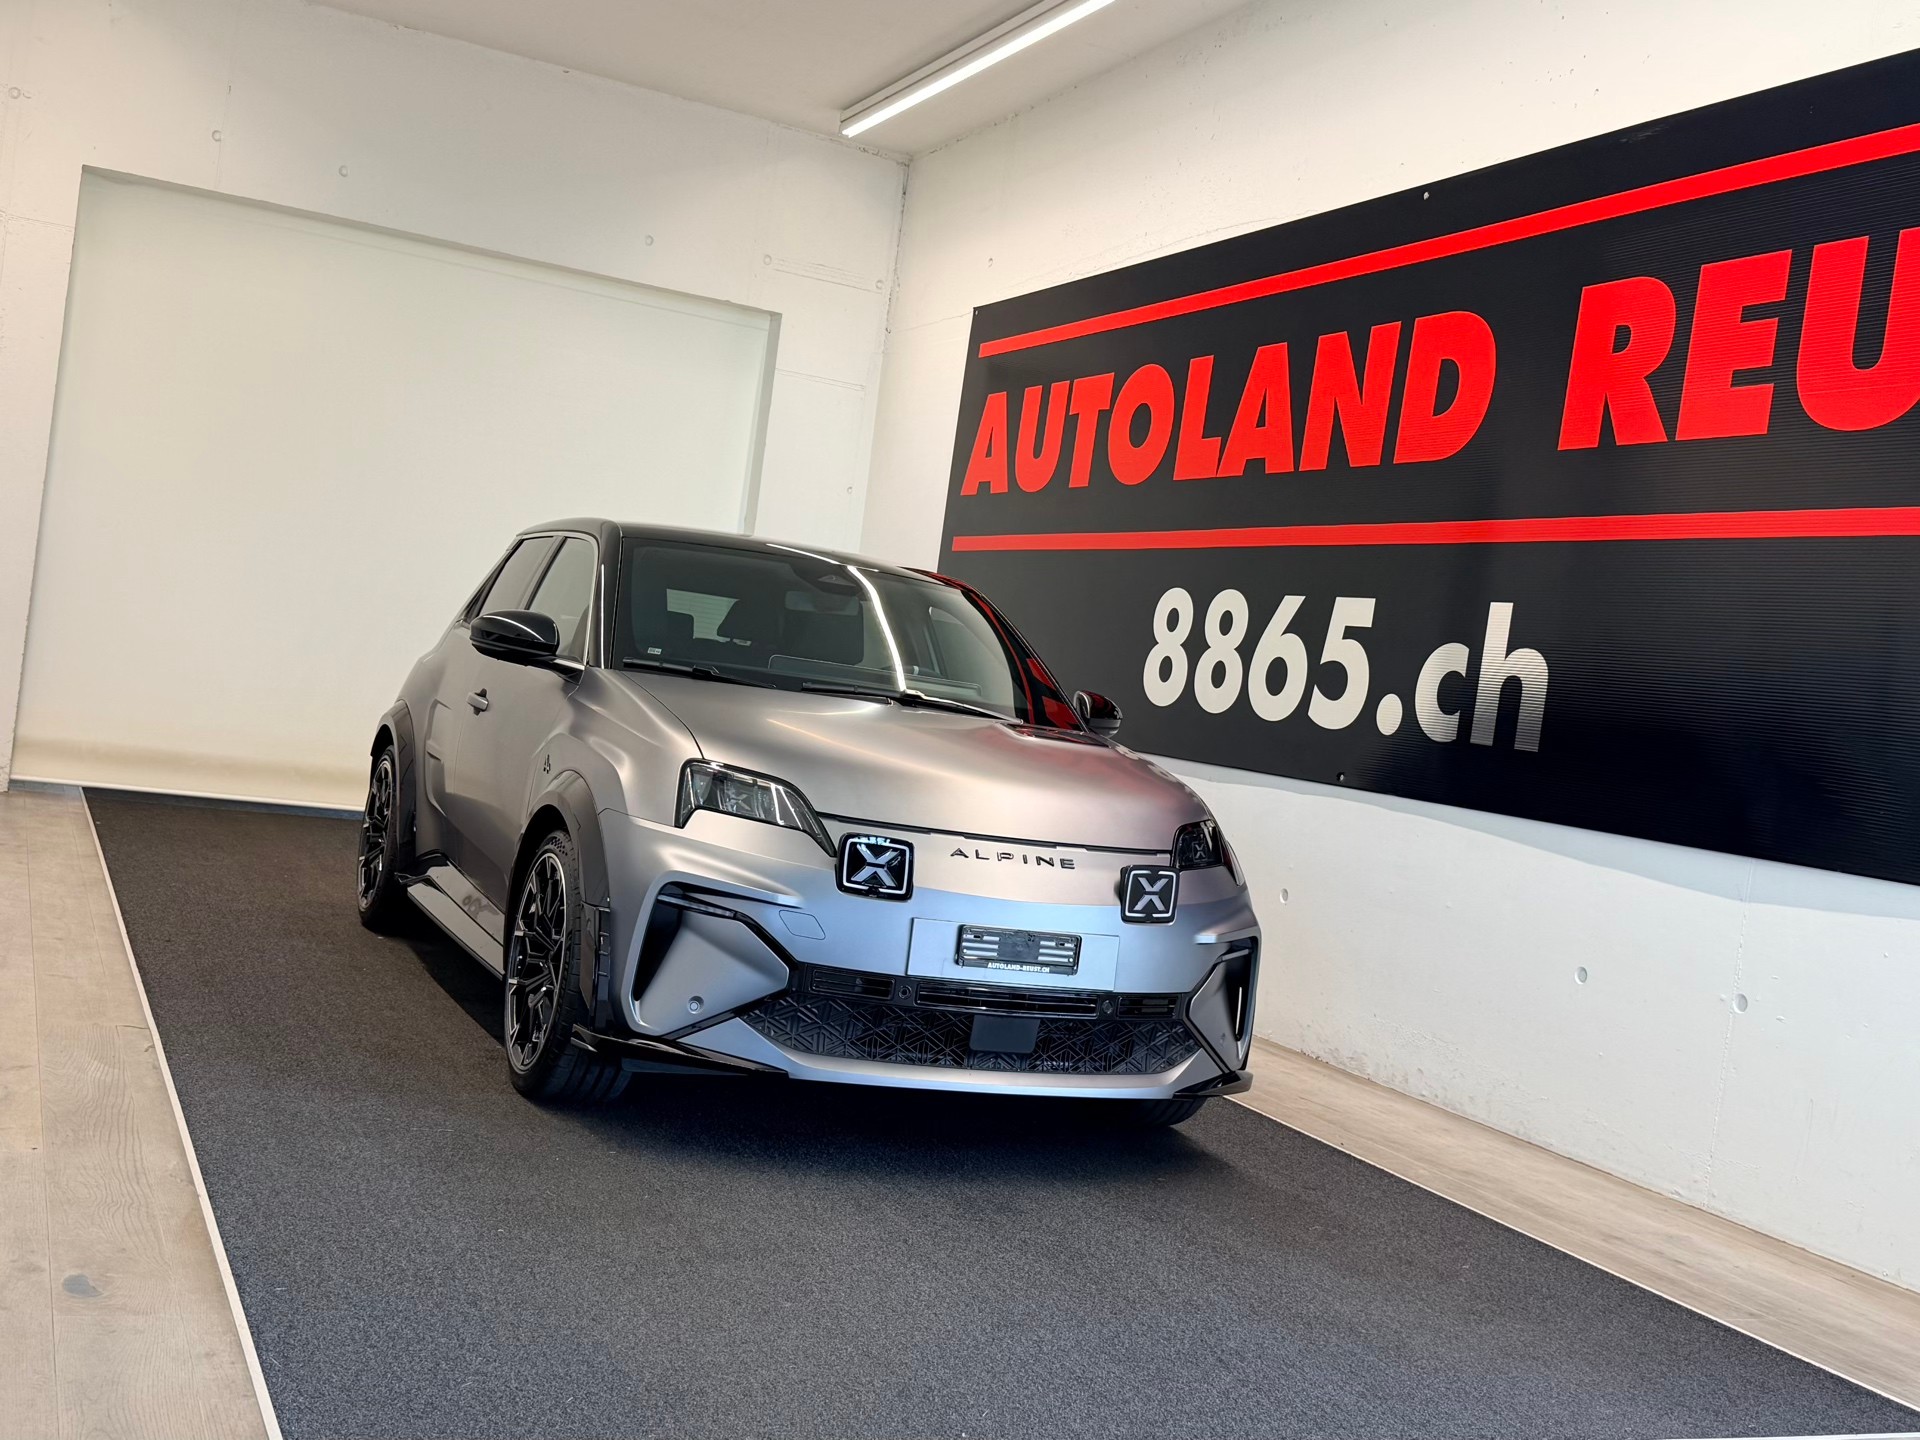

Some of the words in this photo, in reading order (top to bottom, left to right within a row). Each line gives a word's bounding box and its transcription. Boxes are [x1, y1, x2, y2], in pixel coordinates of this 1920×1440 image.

[961, 311, 1496, 496] AUTOLAND
[1558, 227, 1920, 451] REU
[1143, 587, 1549, 752] 8865.ch
[950, 847, 1076, 870] ALPINE
